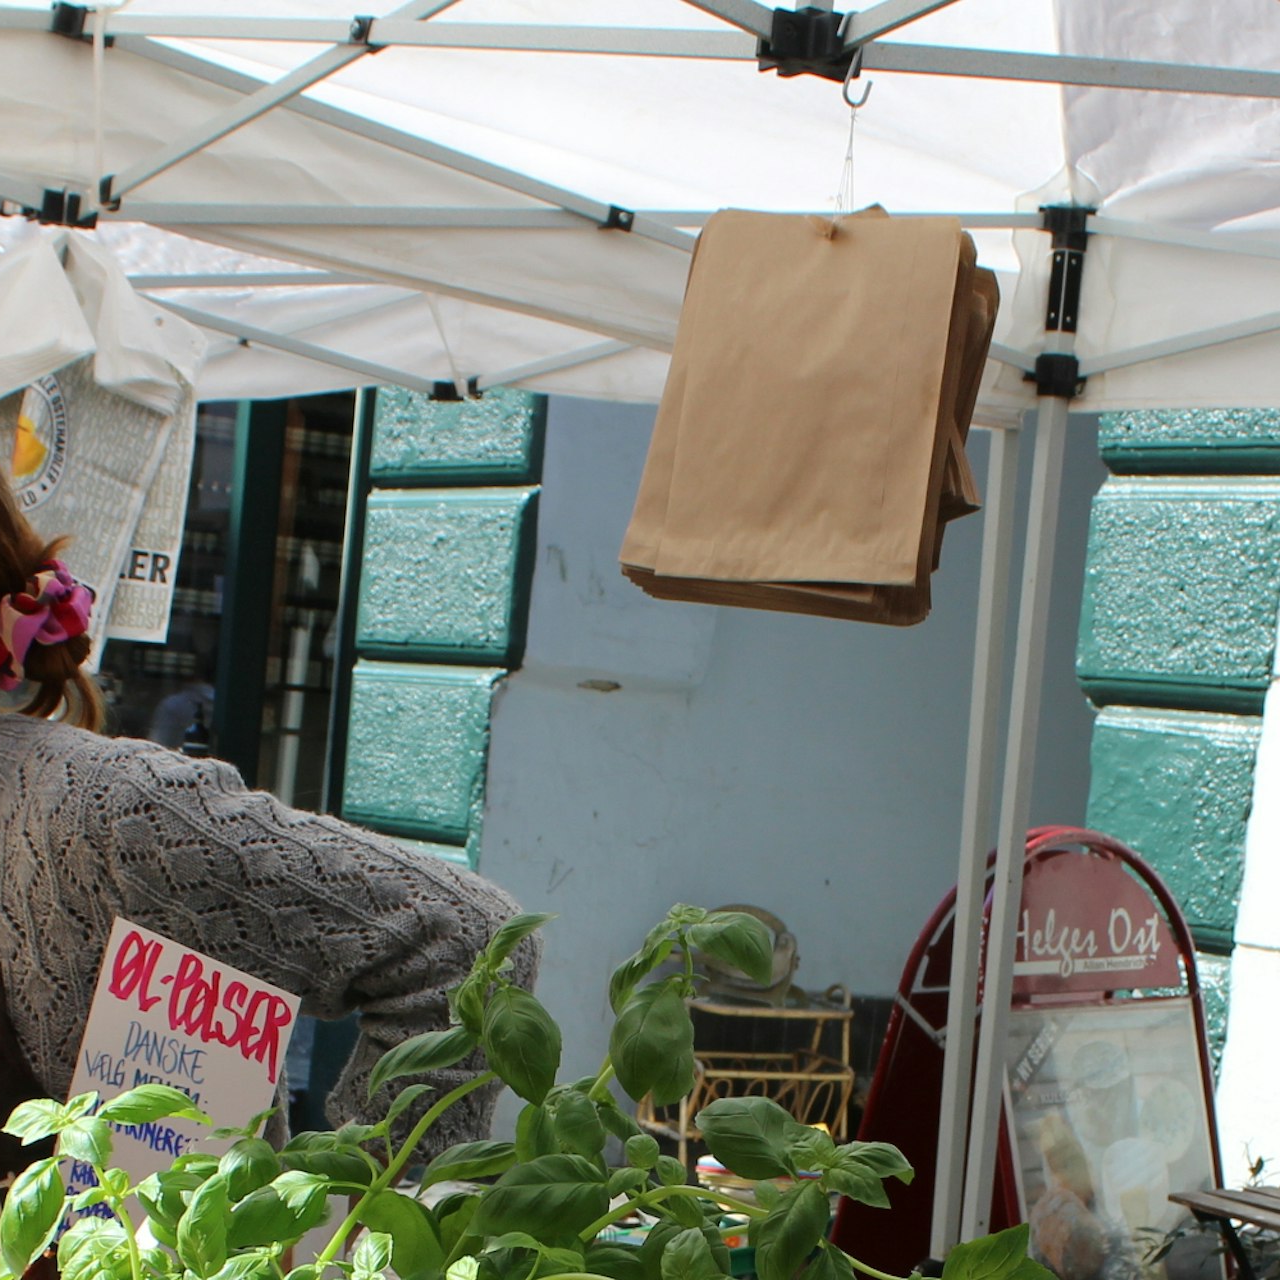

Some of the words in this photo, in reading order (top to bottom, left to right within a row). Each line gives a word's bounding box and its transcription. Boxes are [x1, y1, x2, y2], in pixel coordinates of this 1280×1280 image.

[1016, 908, 1098, 978] Helges
[1107, 907, 1161, 955] Ost
[107, 929, 292, 1084] ØL-PØLSER
[85, 1049, 126, 1089] VÆLG
[124, 1020, 208, 1086] DANSKE
